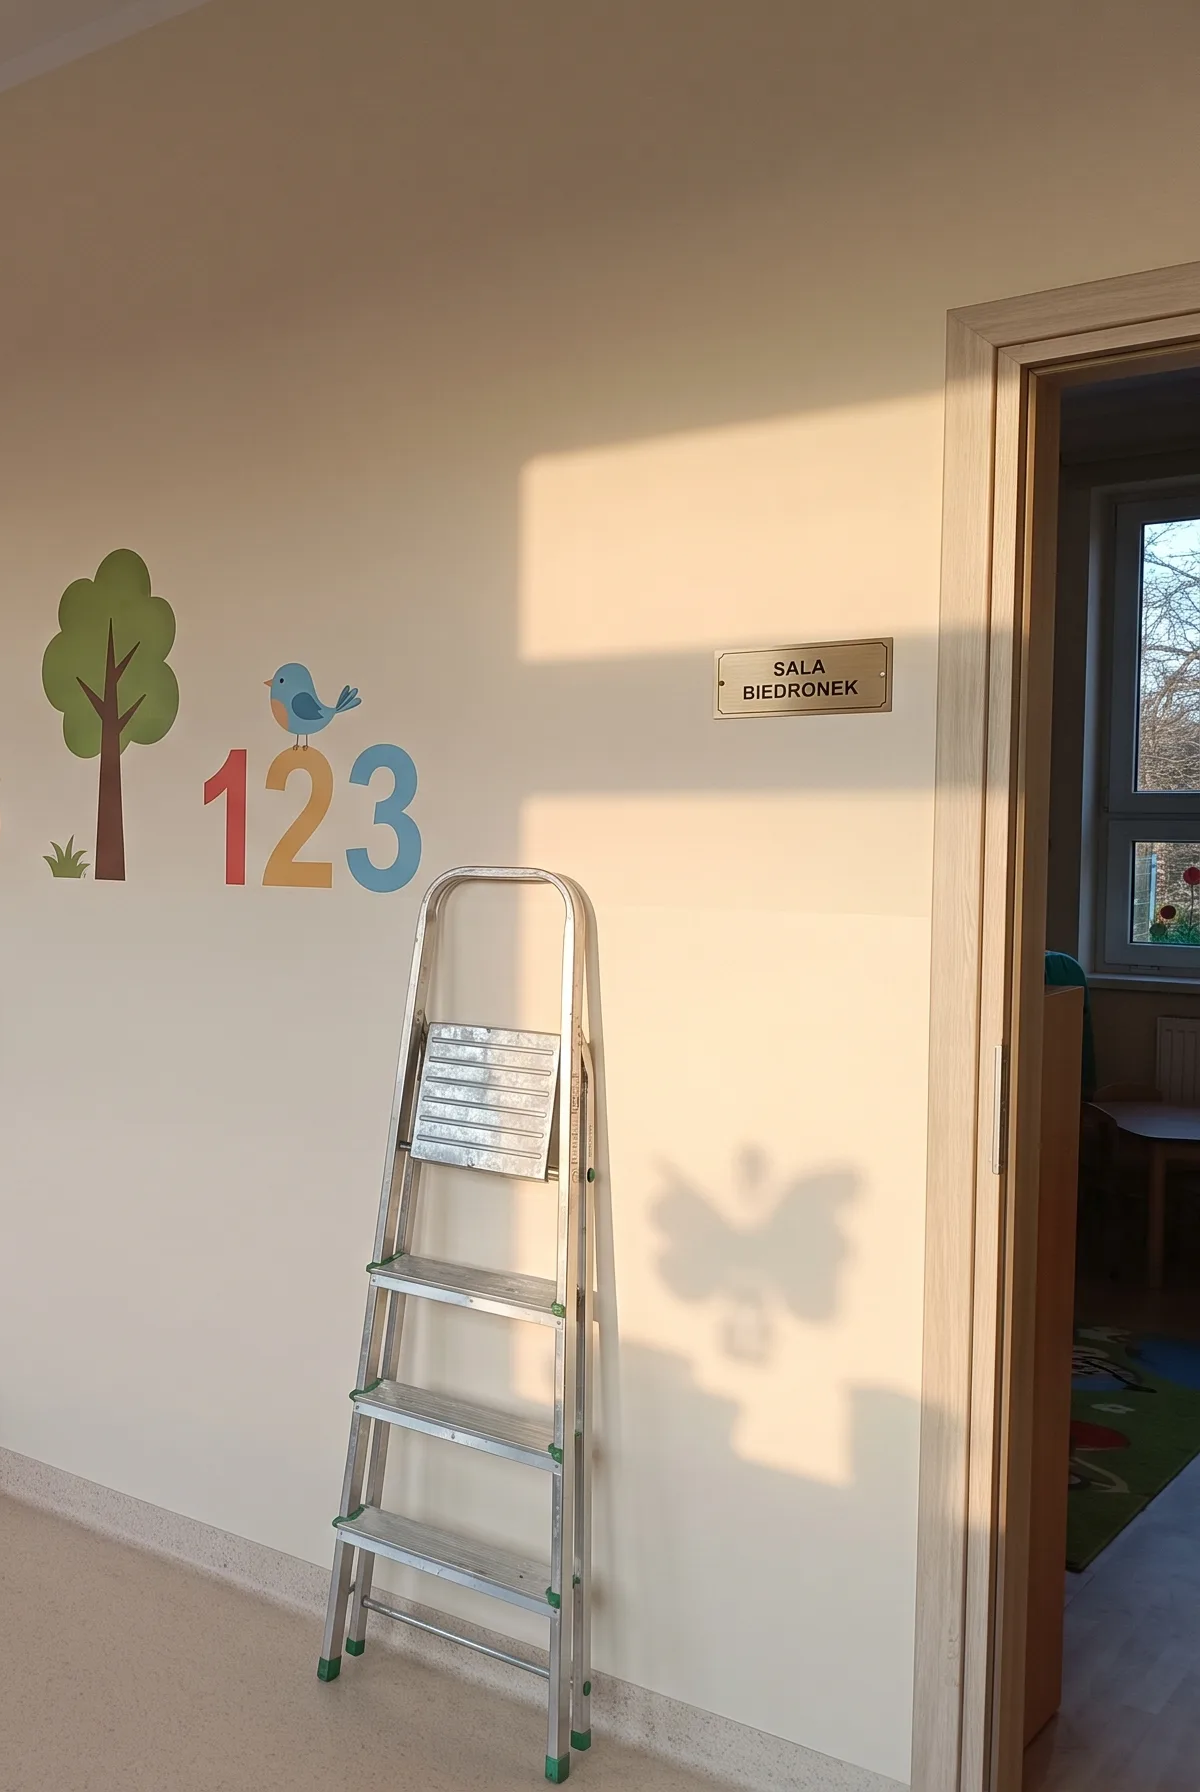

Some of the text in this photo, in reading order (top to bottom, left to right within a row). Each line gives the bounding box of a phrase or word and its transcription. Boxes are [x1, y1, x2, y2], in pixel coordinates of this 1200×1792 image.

[773, 659, 826, 677] SALA
[743, 680, 859, 700] BIEDRONEK
[203, 743, 422, 893] 123
